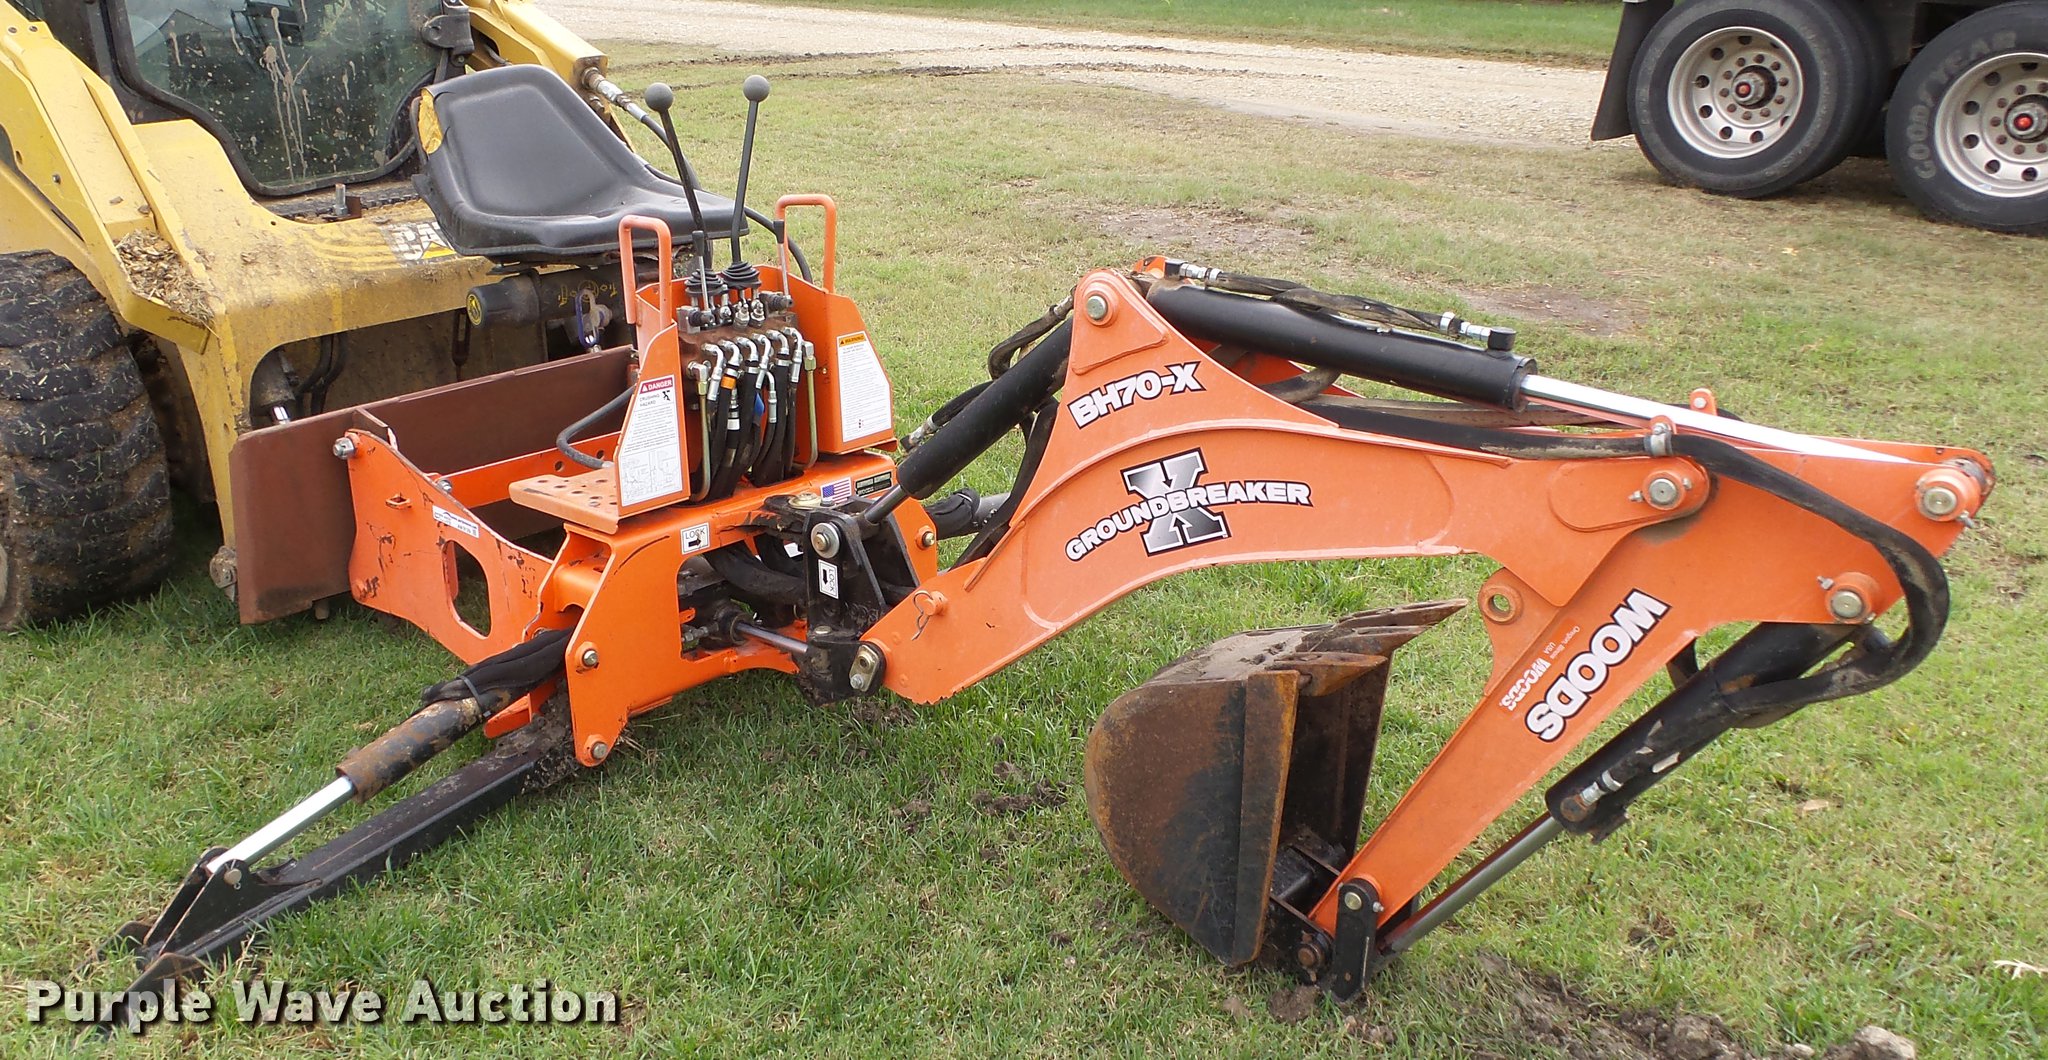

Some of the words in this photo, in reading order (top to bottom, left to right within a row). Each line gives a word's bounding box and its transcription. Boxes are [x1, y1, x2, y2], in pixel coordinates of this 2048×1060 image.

[1907, 31, 2017, 179] GOODYEAR
[648, 379, 672, 391] DANGER
[1067, 361, 1207, 430] BH70-X
[685, 527, 705, 540] LOCK
[1065, 480, 1314, 561] GROUNDBREAKER
[828, 568, 836, 592] LOCK
[1525, 588, 1672, 742] WOODS
